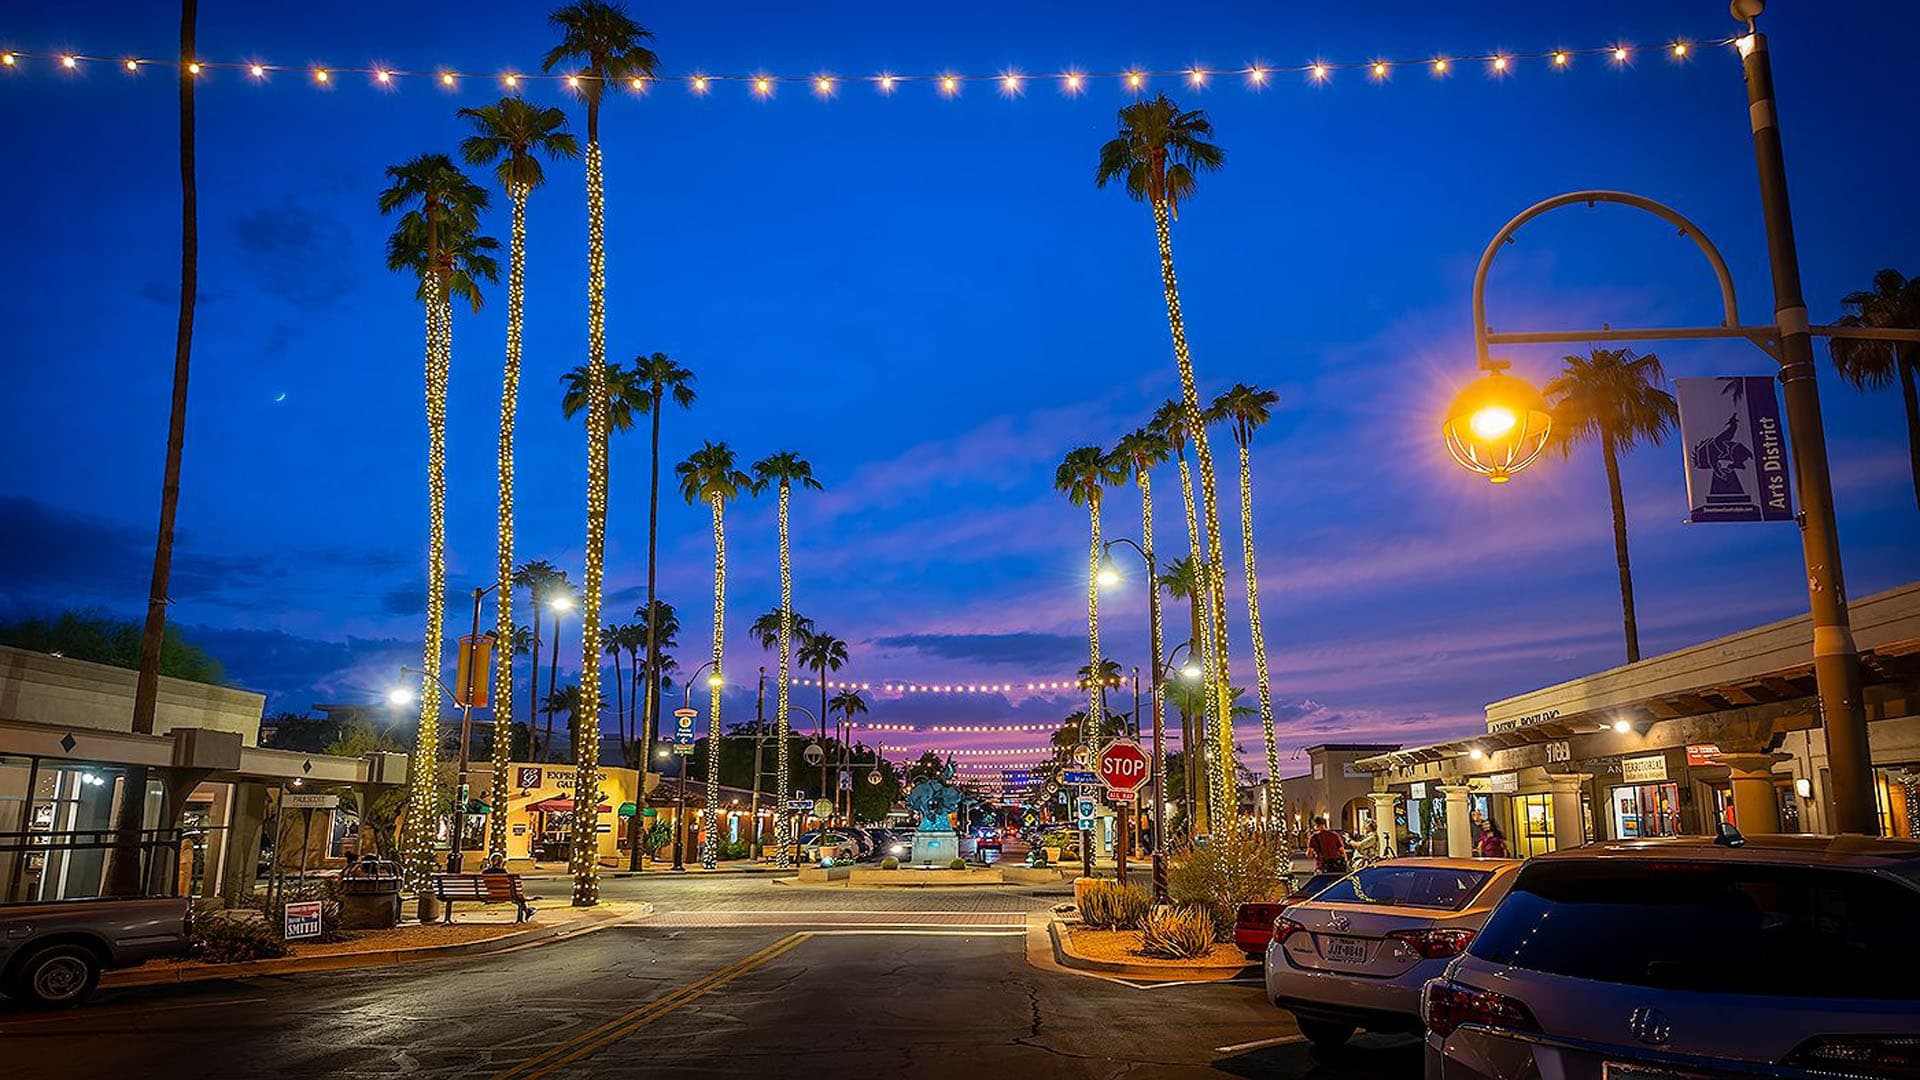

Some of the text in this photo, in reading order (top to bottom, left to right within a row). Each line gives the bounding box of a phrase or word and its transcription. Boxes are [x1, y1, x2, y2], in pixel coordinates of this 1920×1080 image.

[1759, 416, 1786, 509] Arts District
[1103, 757, 1144, 776] STOP
[288, 921, 318, 935] SMITH
